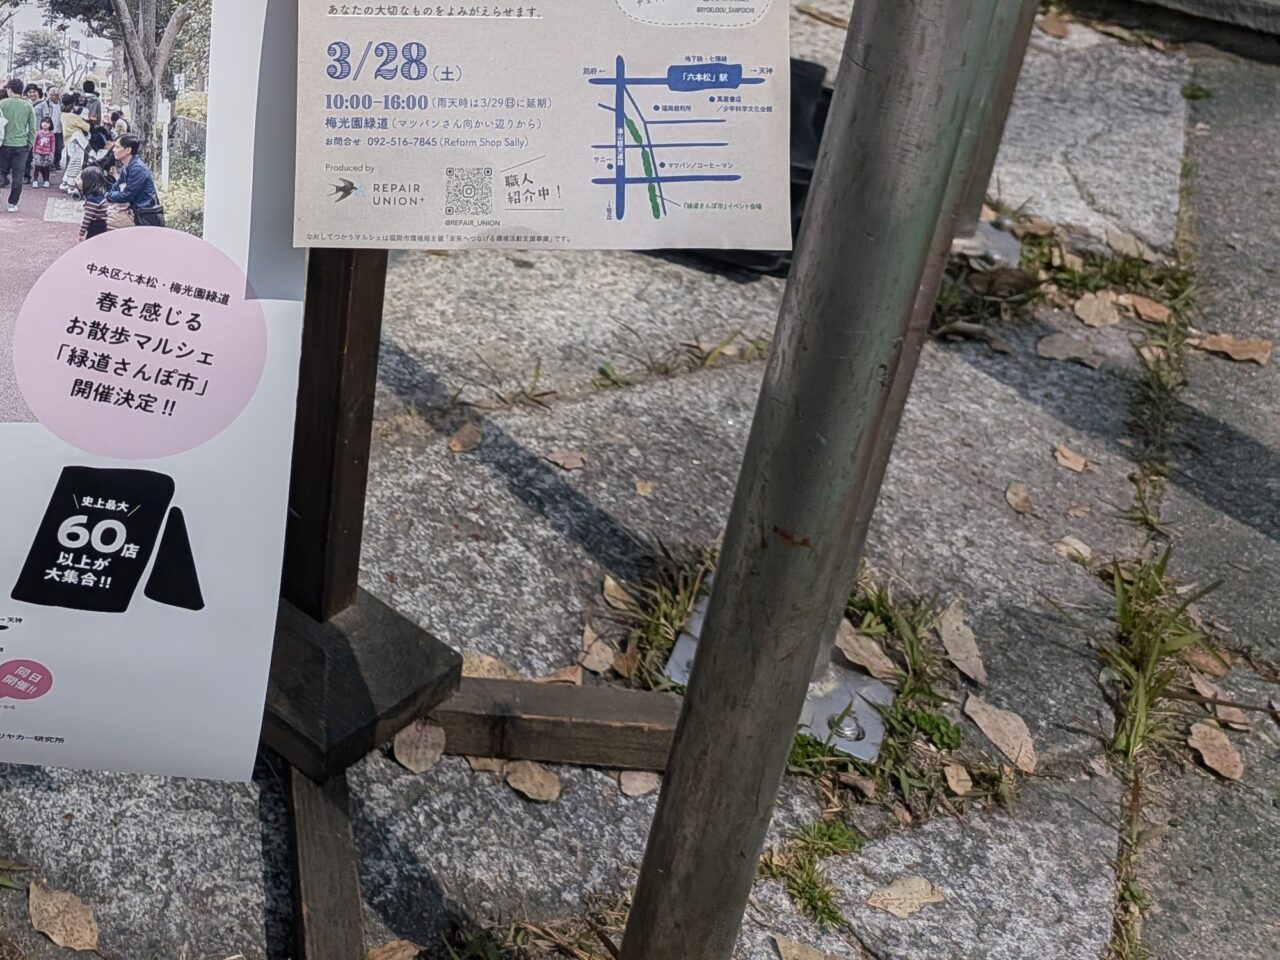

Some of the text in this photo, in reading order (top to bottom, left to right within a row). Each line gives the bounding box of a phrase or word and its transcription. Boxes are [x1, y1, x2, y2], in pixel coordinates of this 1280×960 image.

[327, 3, 544, 18] あなたの大切なものをよみがえらせます。
[326, 41, 428, 81] 3/28
[325, 116, 389, 130] 梅光園緑道
[325, 137, 361, 147] お問合せ
[367, 137, 438, 147] 092-516-7845
[479, 138, 502, 149] Shop
[325, 164, 375, 174] Produced by
[373, 183, 421, 193] REPAIR
[505, 173, 534, 187] 職人
[86, 262, 231, 306] 中央区六本松・梅光園緑道
[96, 291, 202, 332] 春を感じる
[66, 316, 214, 366] お散歩マルシェ
[56, 343, 209, 397] 「緑道さんぽ市」
[81, 496, 130, 512] 史上最大
[56, 551, 112, 571] 以上が
[14, 666, 43, 684] 同日
